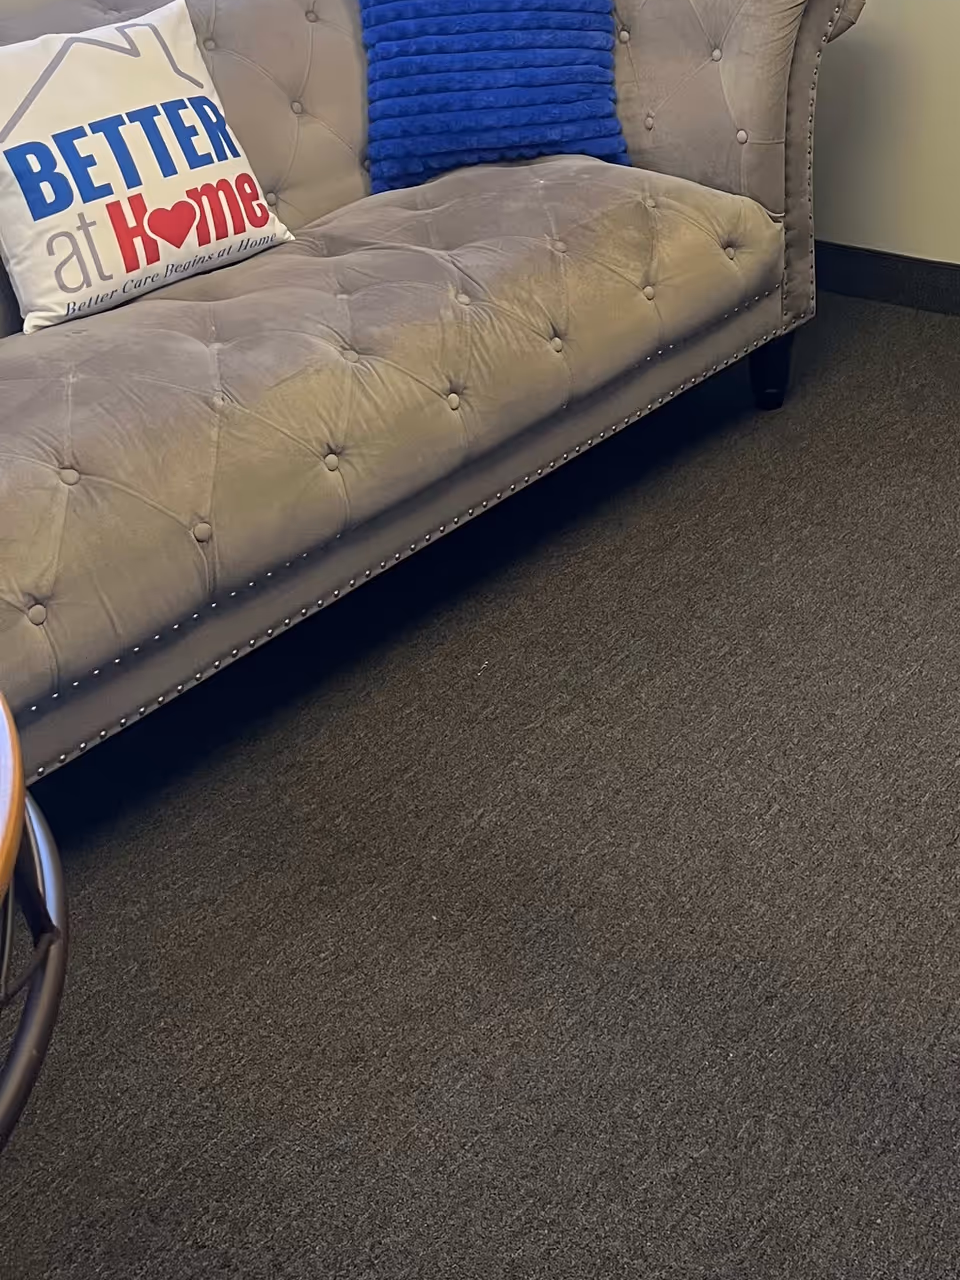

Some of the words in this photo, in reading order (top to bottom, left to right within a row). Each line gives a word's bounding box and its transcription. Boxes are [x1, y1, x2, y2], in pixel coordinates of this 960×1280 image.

[3, 95, 241, 222] BETTER
[46, 211, 113, 294] at
[65, 287, 118, 317] Better
[122, 272, 160, 294] Care
[164, 252, 214, 279] Begins
[217, 243, 233, 258] at
[237, 233, 277, 252] Home
